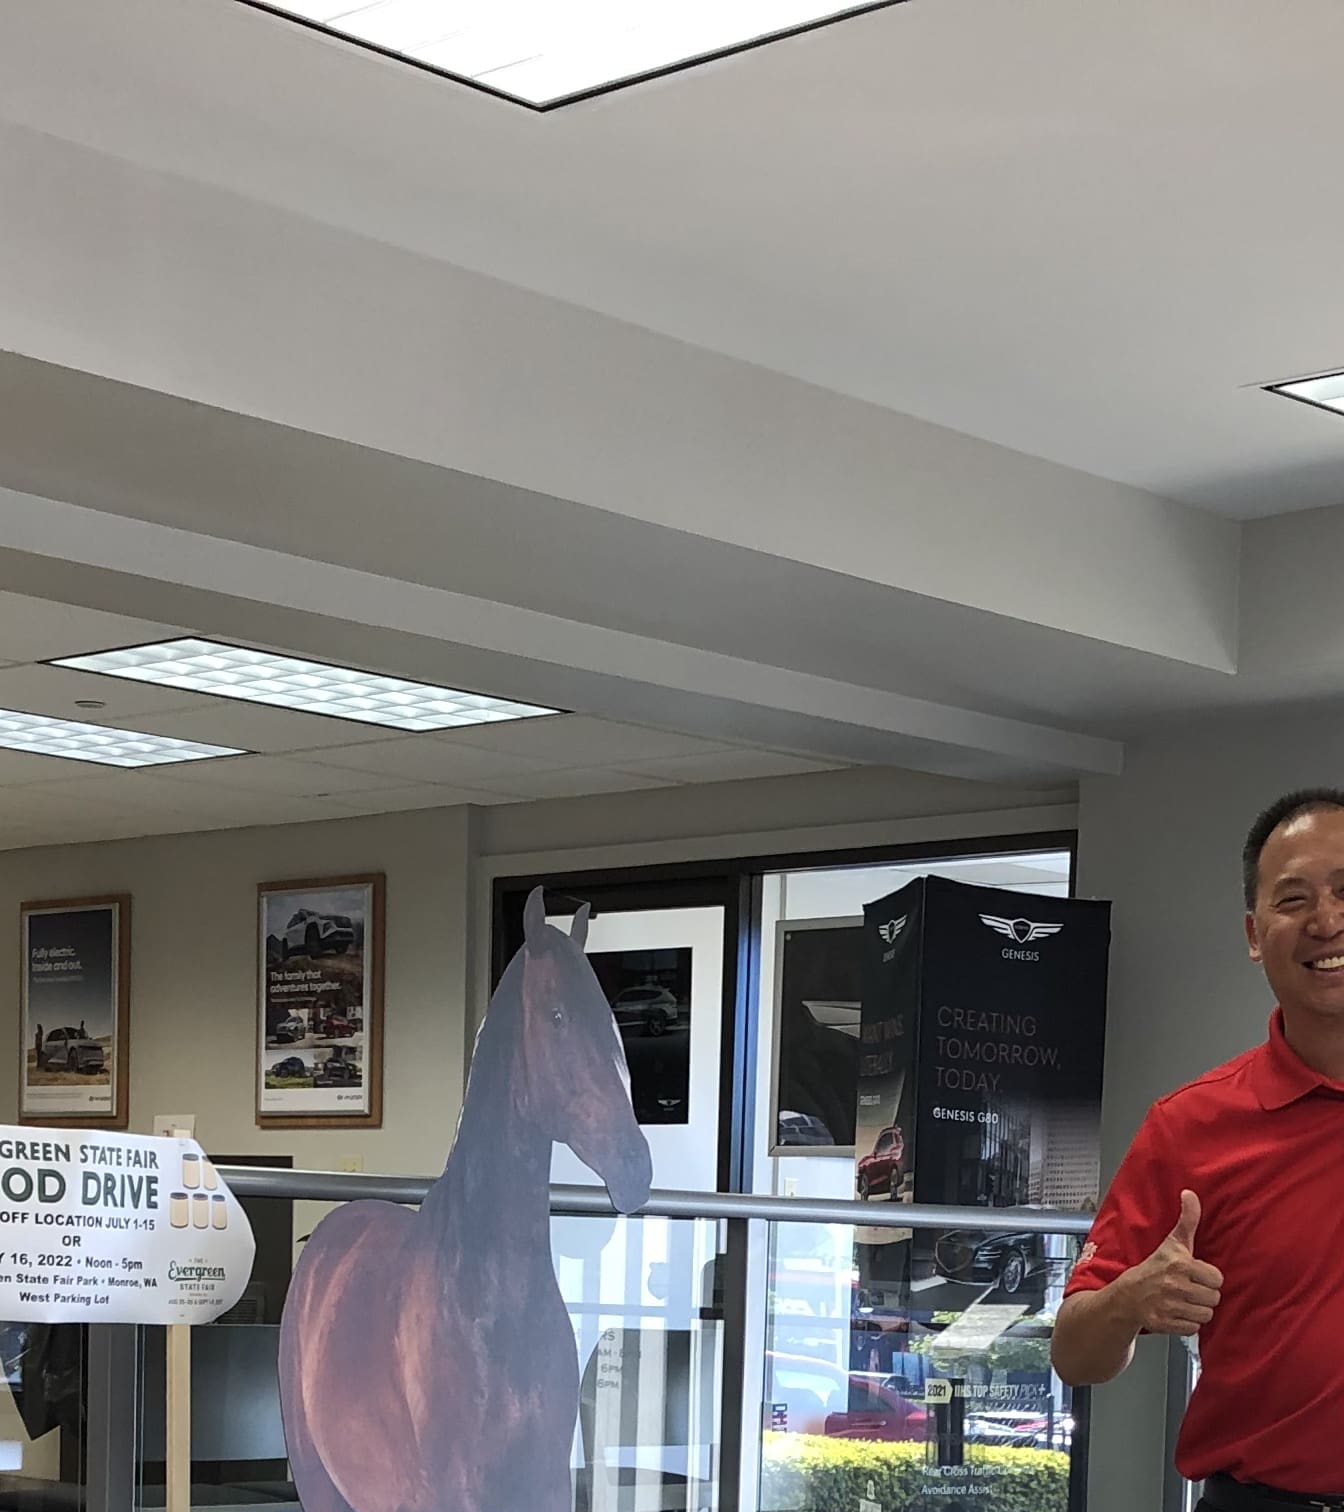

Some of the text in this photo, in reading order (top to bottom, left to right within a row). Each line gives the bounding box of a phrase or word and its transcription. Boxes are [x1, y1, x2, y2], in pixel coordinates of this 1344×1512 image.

[1001, 947, 1040, 962] GENESIS
[937, 1005, 1037, 1036] CREATING
[933, 1106, 999, 1125] GENESIS G80
[79, 1145, 122, 1166] STATE
[126, 1149, 159, 1169] FAIR
[81, 1171, 159, 1209] DRIVE
[0, 1211, 29, 1224] OFF
[34, 1213, 103, 1229] LOCATION
[105, 1217, 131, 1230] JULY
[133, 1219, 156, 1231] 1-15
[61, 1235, 81, 1247] OR
[10, 1253, 33, 1267] 16,
[37, 1254, 73, 1267] 2022
[85, 1256, 113, 1269] Noon
[121, 1258, 143, 1272] 5pm
[168, 1260, 225, 1282] Evergreen
[16, 1273, 49, 1285] State
[53, 1275, 74, 1286] Fair
[76, 1276, 99, 1287] Park
[108, 1277, 142, 1289] Monroe,
[144, 1278, 158, 1288] WA
[19, 1292, 110, 1306] West Parking Lot
[927, 1384, 946, 1397] 2021
[972, 1385, 989, 1398] TOP
[989, 1384, 1019, 1400] SAFETY
[922, 1465, 942, 1478] Rear
[943, 1465, 968, 1477] Cross
[921, 1484, 993, 1495] Avoidance Assist
